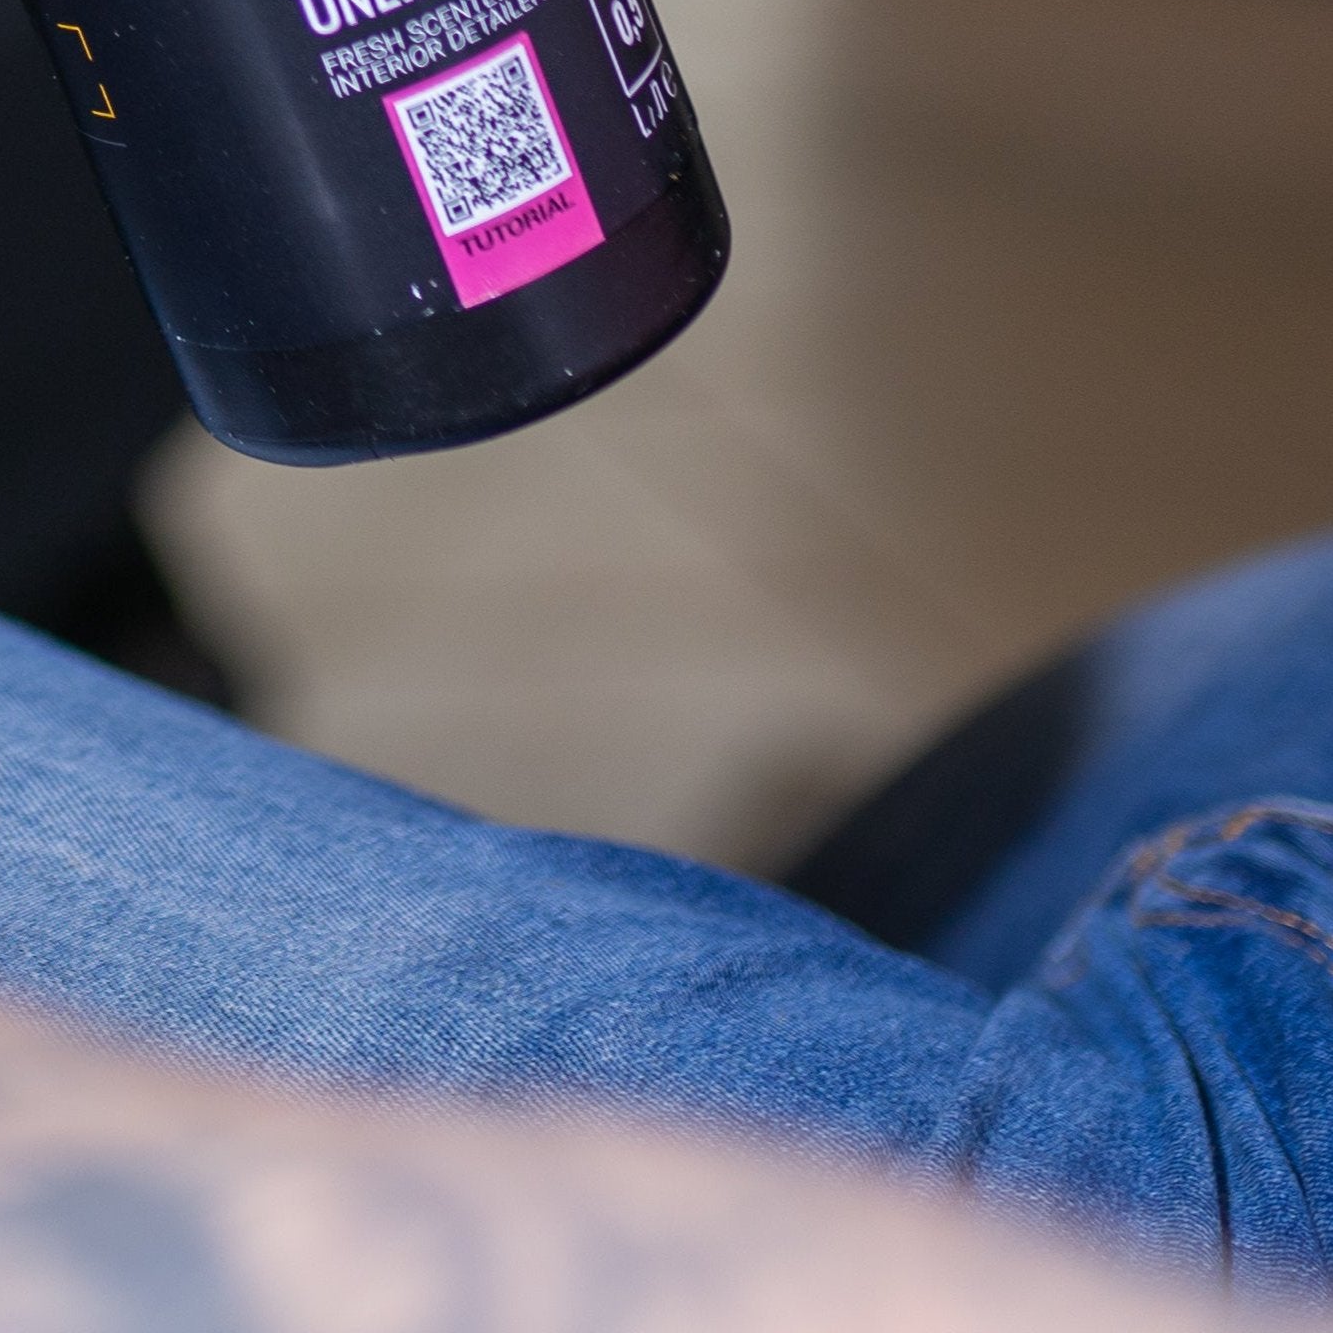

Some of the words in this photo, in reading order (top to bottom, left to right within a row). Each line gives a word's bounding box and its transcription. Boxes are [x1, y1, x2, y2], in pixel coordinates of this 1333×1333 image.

[321, 27, 406, 76] FRESH
[330, 38, 447, 99] INTERIOR
[458, 191, 576, 258] TUTORIAL
